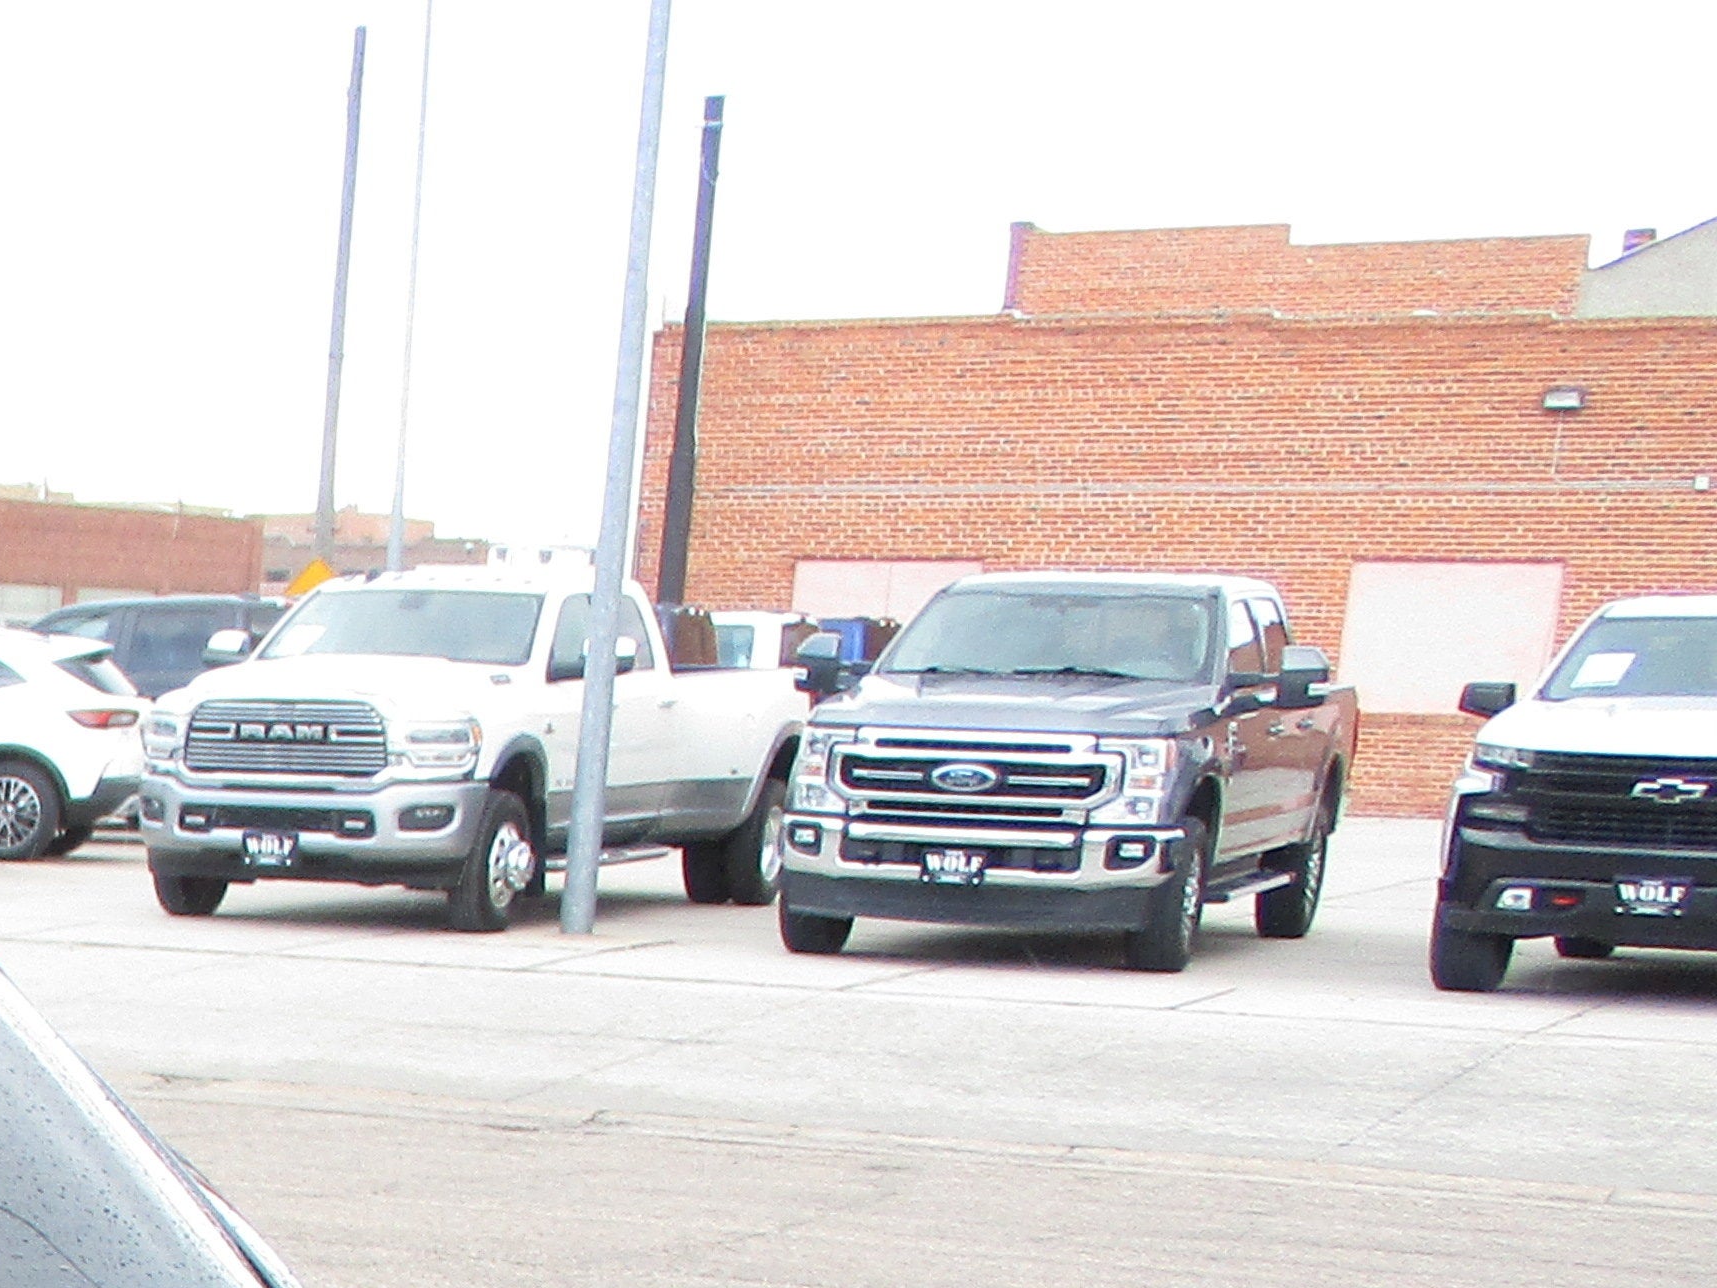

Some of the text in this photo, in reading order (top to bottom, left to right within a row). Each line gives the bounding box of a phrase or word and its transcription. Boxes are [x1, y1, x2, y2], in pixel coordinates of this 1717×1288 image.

[239, 722, 324, 741] RAM
[246, 836, 294, 856] WOLF
[925, 853, 983, 872] WOLF
[1618, 884, 1686, 903] WOLF
